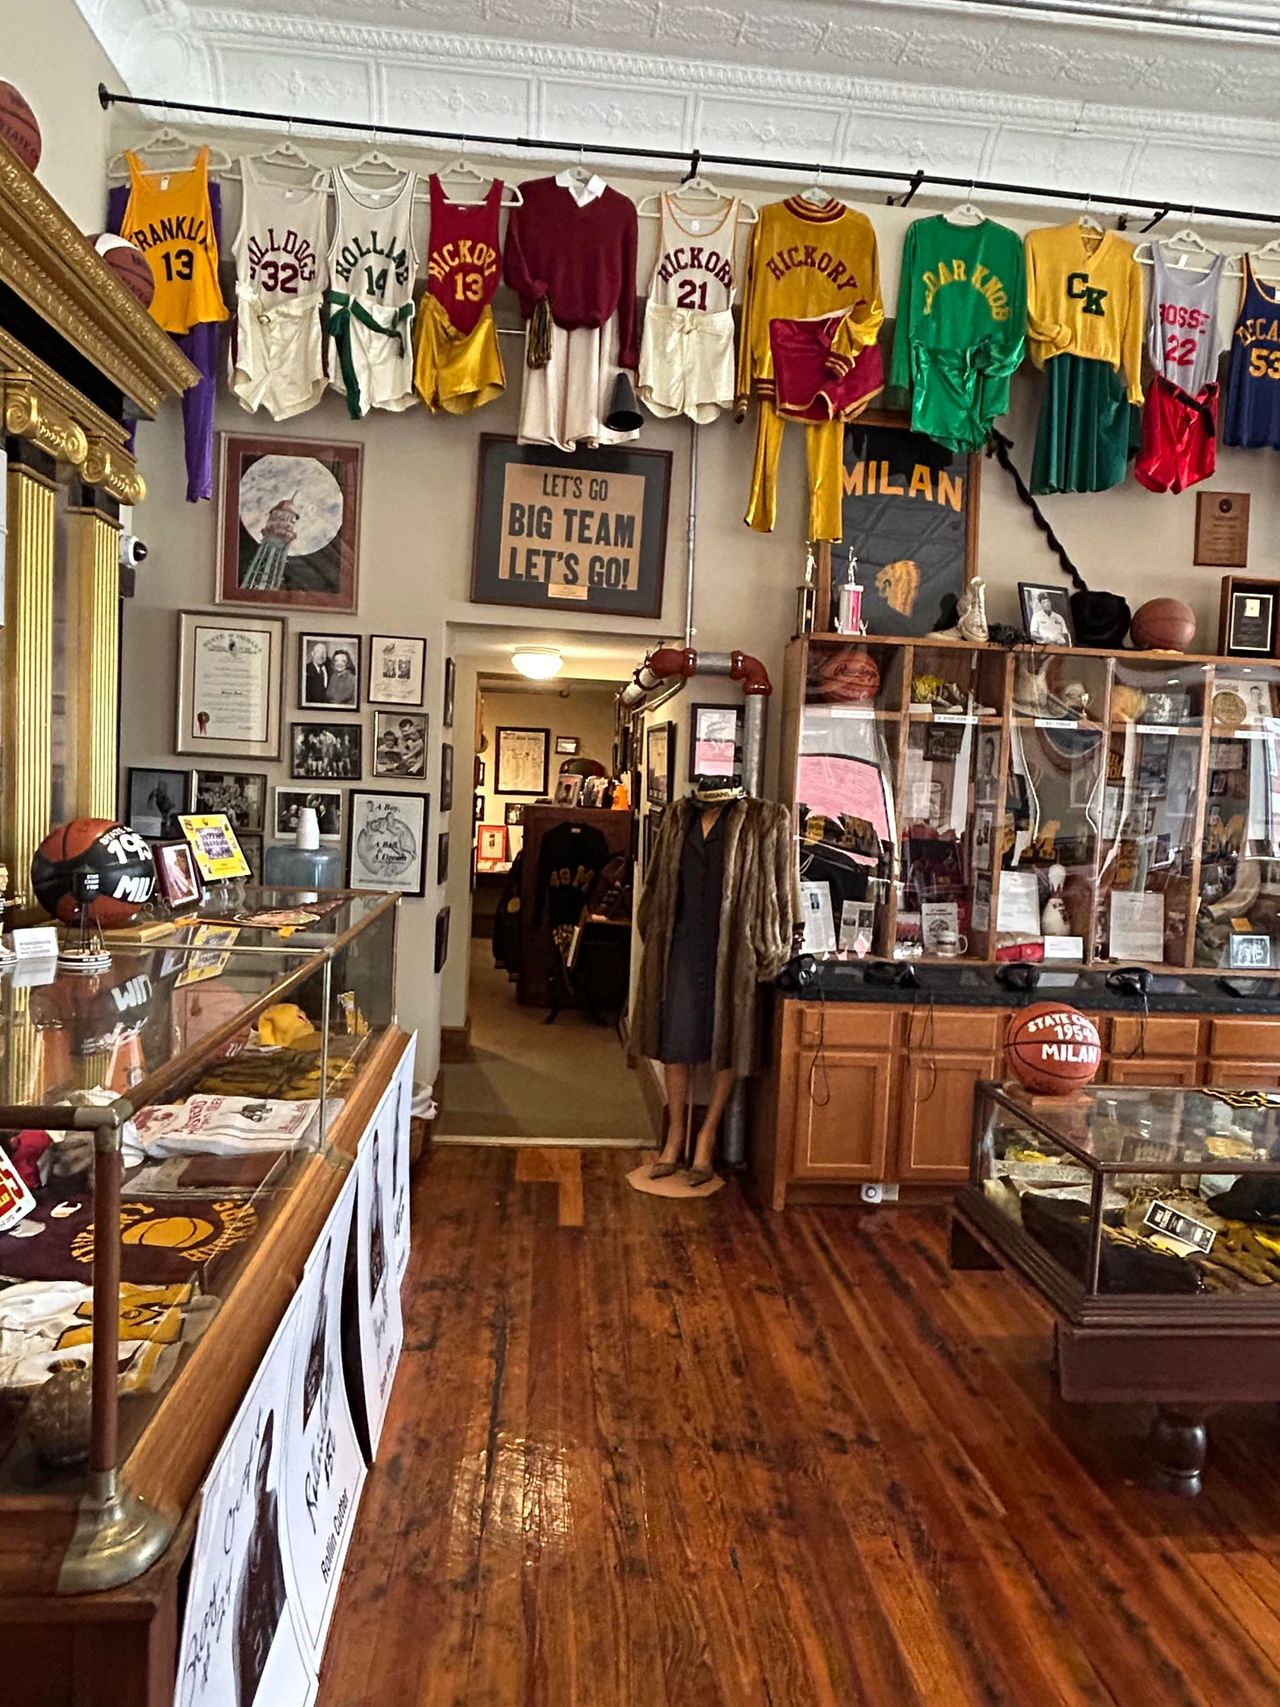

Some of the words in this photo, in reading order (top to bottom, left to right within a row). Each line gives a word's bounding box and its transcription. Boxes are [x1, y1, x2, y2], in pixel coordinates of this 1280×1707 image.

[161, 248, 194, 282] 13
[261, 260, 299, 294] 32
[365, 264, 389, 299] 14
[766, 245, 859, 291] HICKORY
[454, 272, 484, 302] 13
[677, 279, 708, 312] 21
[1165, 334, 1198, 367] 22
[542, 473, 583, 499] LET'S
[589, 478, 609, 501] GO
[842, 460, 963, 513] MILAN
[508, 502, 553, 540] BIG
[563, 508, 636, 549] TEAM
[508, 547, 580, 586] LET'S
[588, 555, 631, 590] GO!
[1027, 1013, 1070, 1033] STATE
[1053, 1024, 1092, 1042] 1954
[1041, 1043, 1098, 1063] MILAN
[321, 1532, 337, 1584] Rollin
[333, 1487, 349, 1536] Cutter
